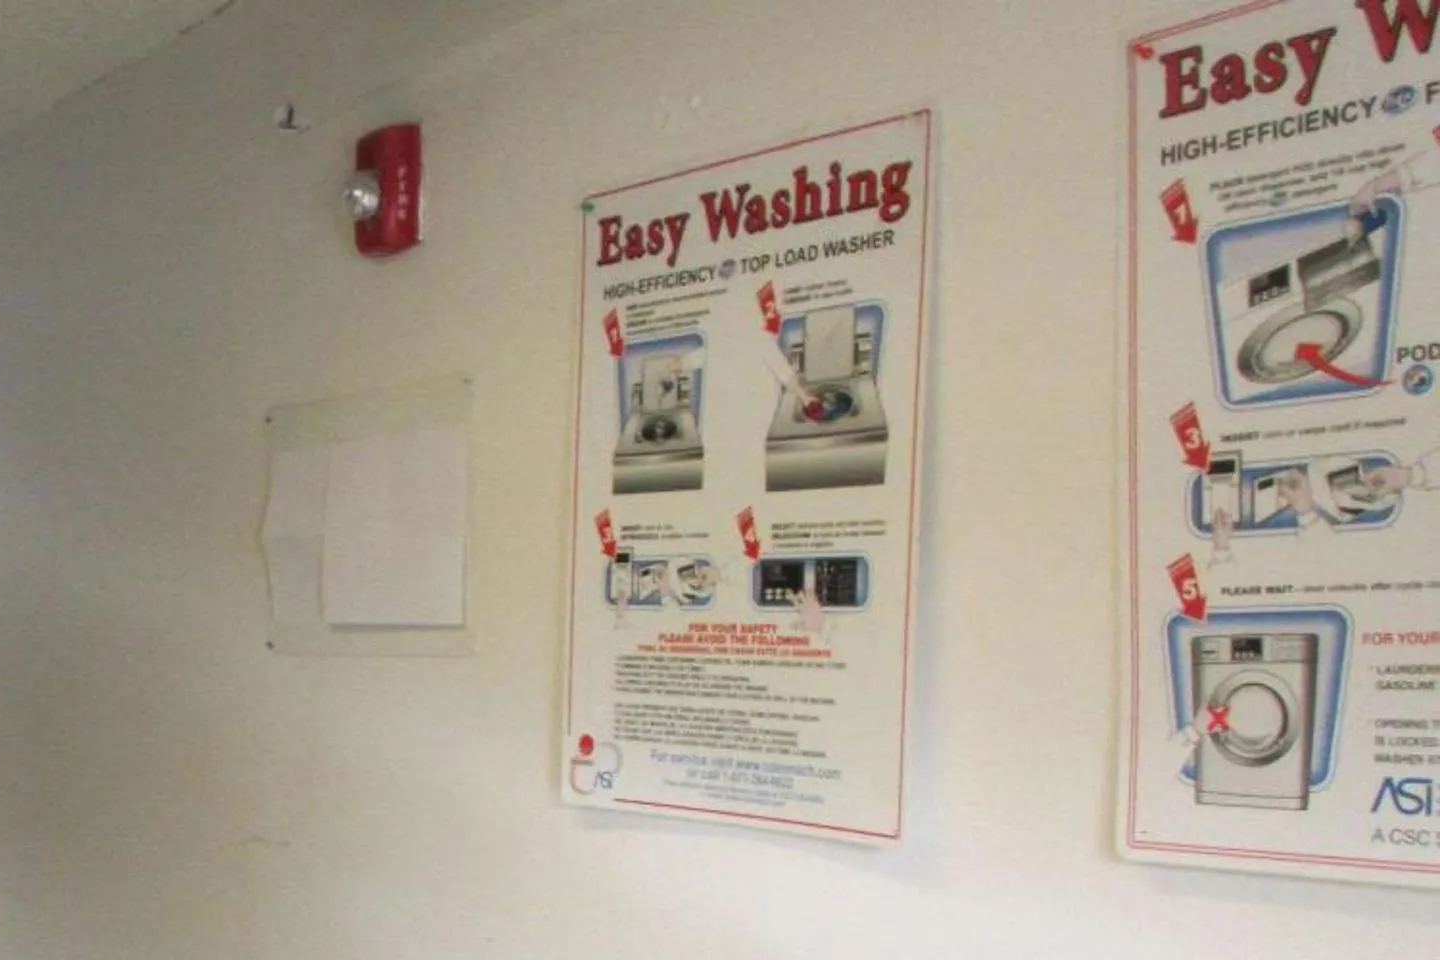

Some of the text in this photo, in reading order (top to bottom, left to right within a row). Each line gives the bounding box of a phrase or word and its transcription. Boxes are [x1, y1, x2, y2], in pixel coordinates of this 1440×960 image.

[1158, 26, 1337, 119] Easy
[1160, 95, 1377, 167] HIGH-EFFICIENCY
[597, 160, 912, 268] Easy Washing
[603, 229, 895, 300] HIGH-EFFICIENCY TOP LOAD WASHER
[1362, 631, 1392, 645] FOR
[1371, 828, 1385, 843] A
[1389, 828, 1430, 846] CSC
